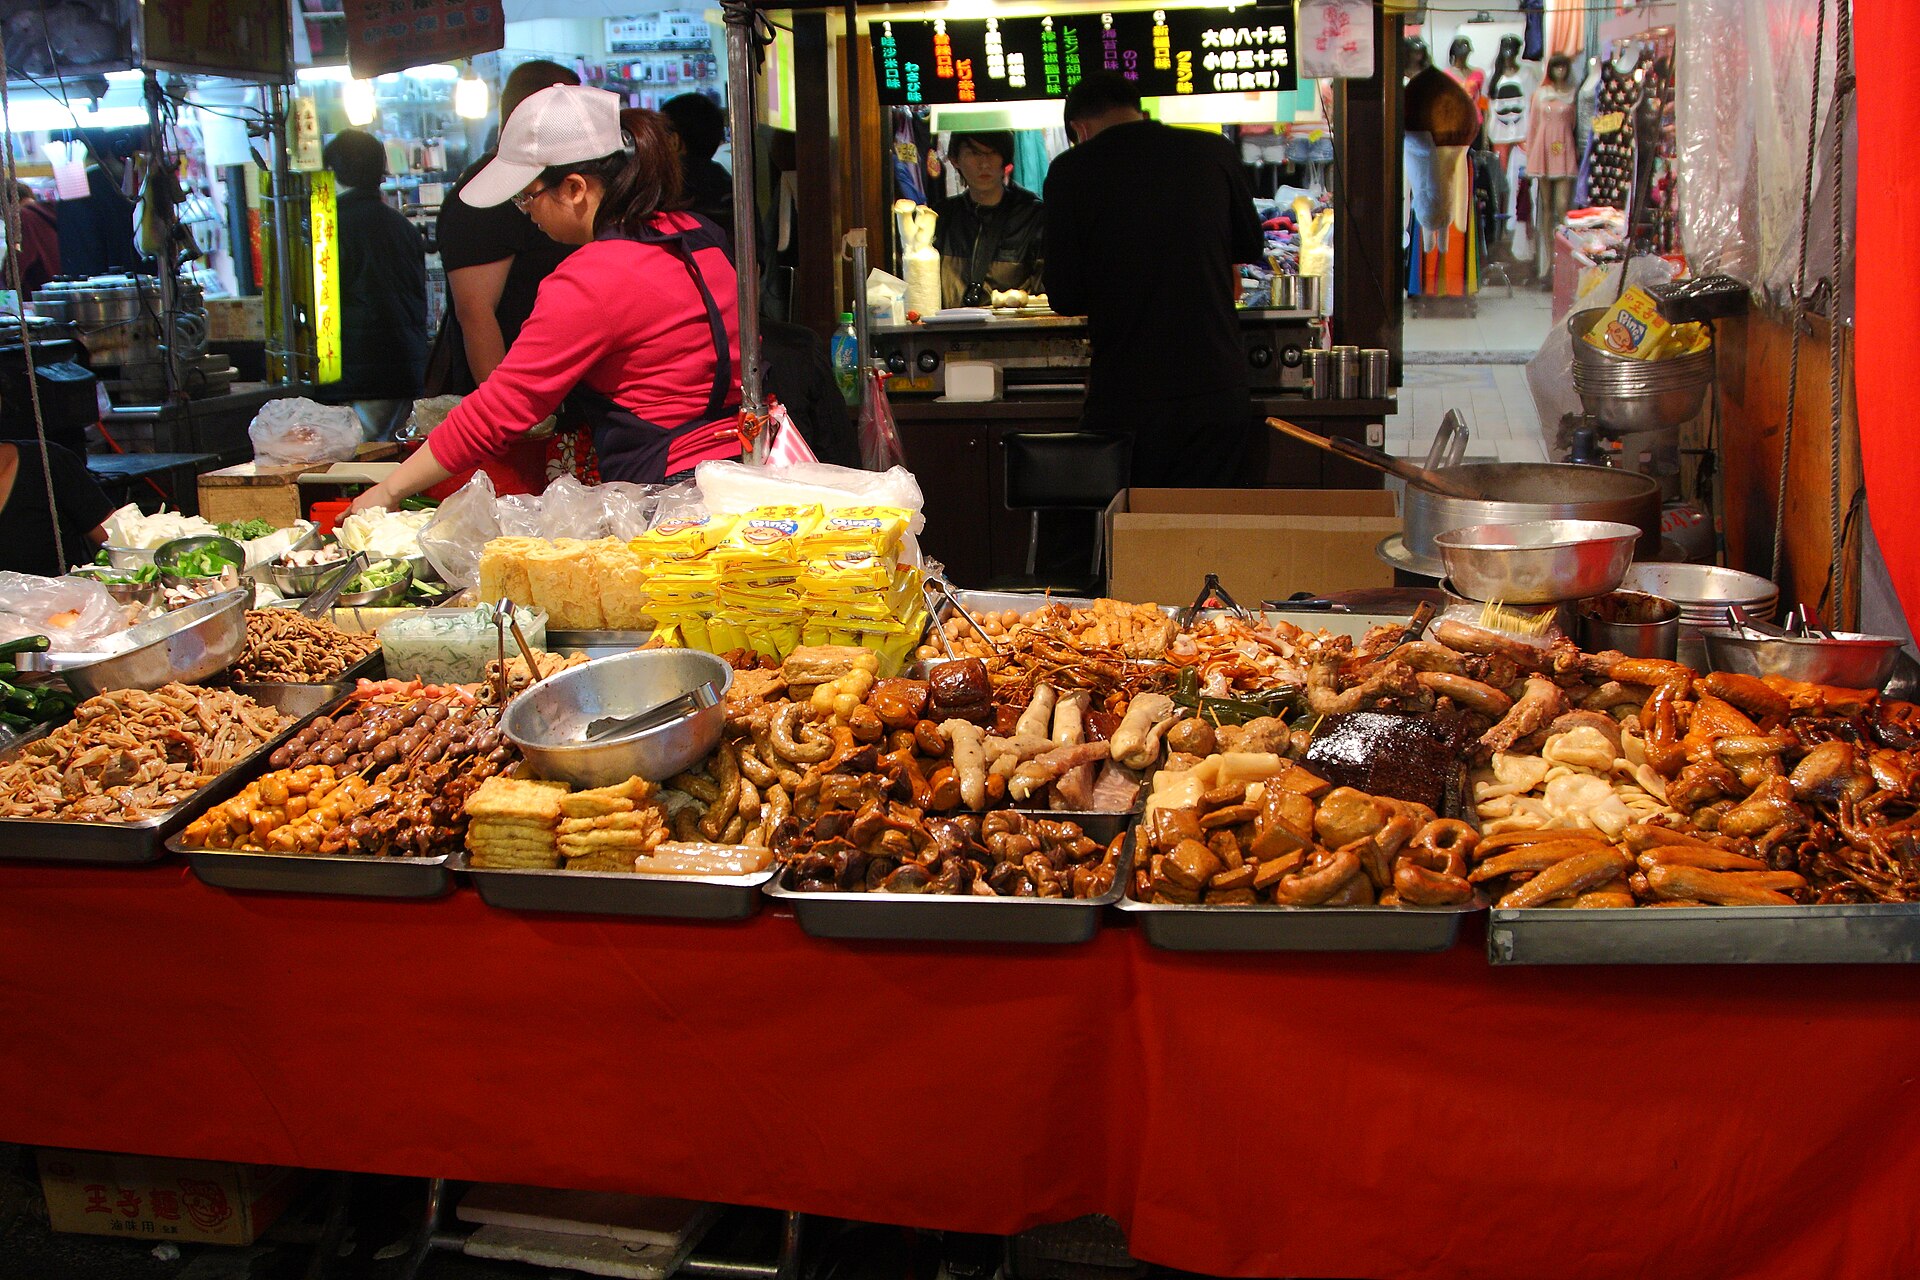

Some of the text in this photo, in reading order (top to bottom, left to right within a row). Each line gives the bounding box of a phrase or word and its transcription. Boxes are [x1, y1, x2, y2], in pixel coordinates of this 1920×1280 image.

[1063, 25, 1082, 92] レモン塩胡椒
[1122, 50, 1139, 82] のり味
[904, 61, 922, 102] わさび味
[83, 1184, 182, 1221] 王子麵
